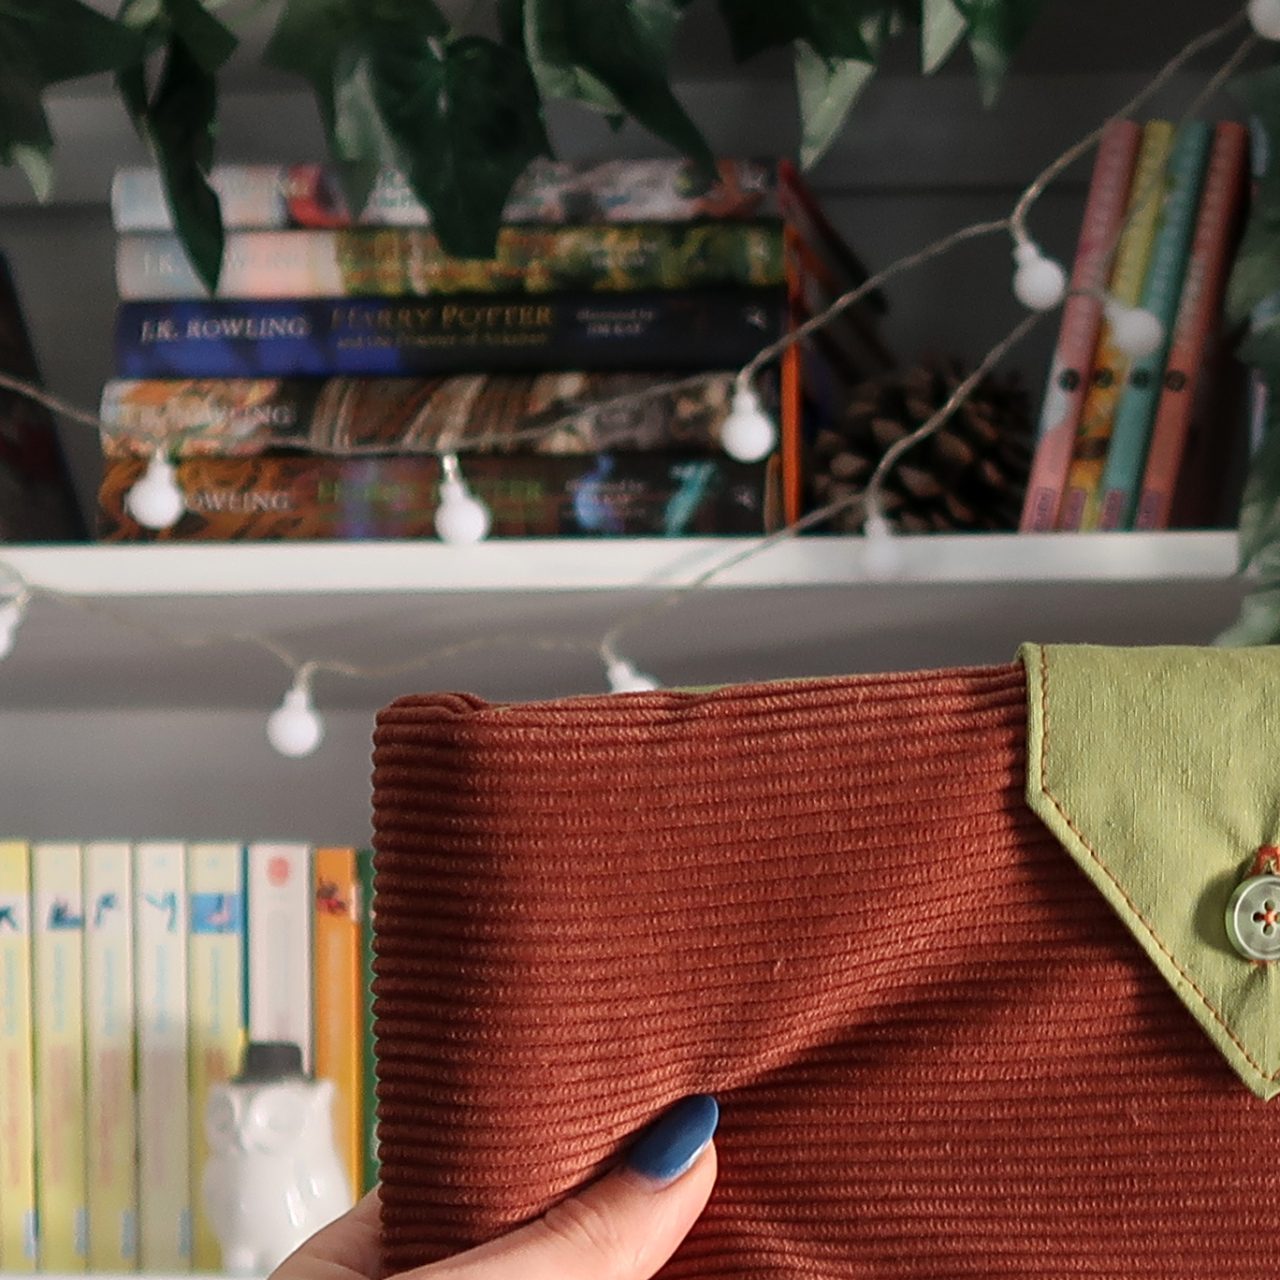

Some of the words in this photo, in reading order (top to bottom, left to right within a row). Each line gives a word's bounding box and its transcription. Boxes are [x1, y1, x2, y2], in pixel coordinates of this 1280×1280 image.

[186, 315, 311, 340] ROWLING
[331, 305, 434, 330] HARRY
[441, 303, 554, 328] POTTER
